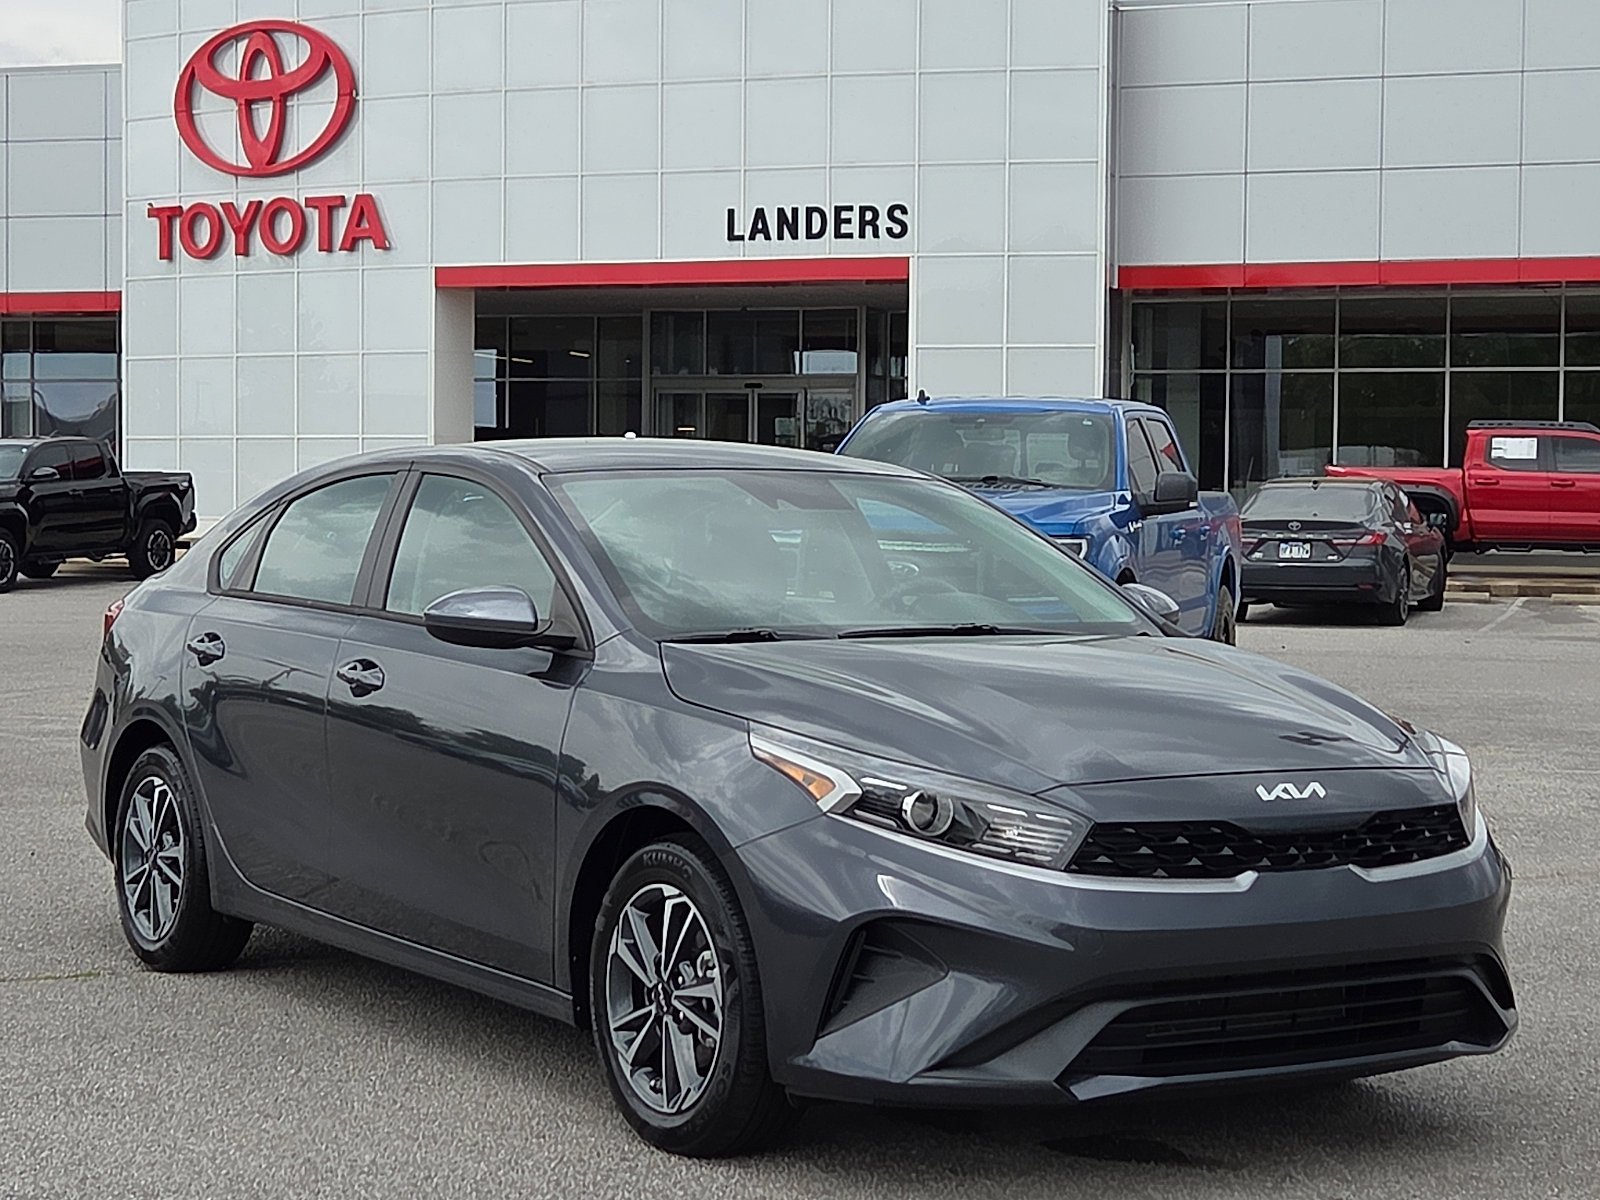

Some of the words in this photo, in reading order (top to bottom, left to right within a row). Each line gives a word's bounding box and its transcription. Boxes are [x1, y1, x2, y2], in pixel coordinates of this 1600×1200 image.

[147, 194, 390, 260] TOYOTA
[727, 204, 909, 241] LANDERS
[1256, 782, 1326, 801] KIA
